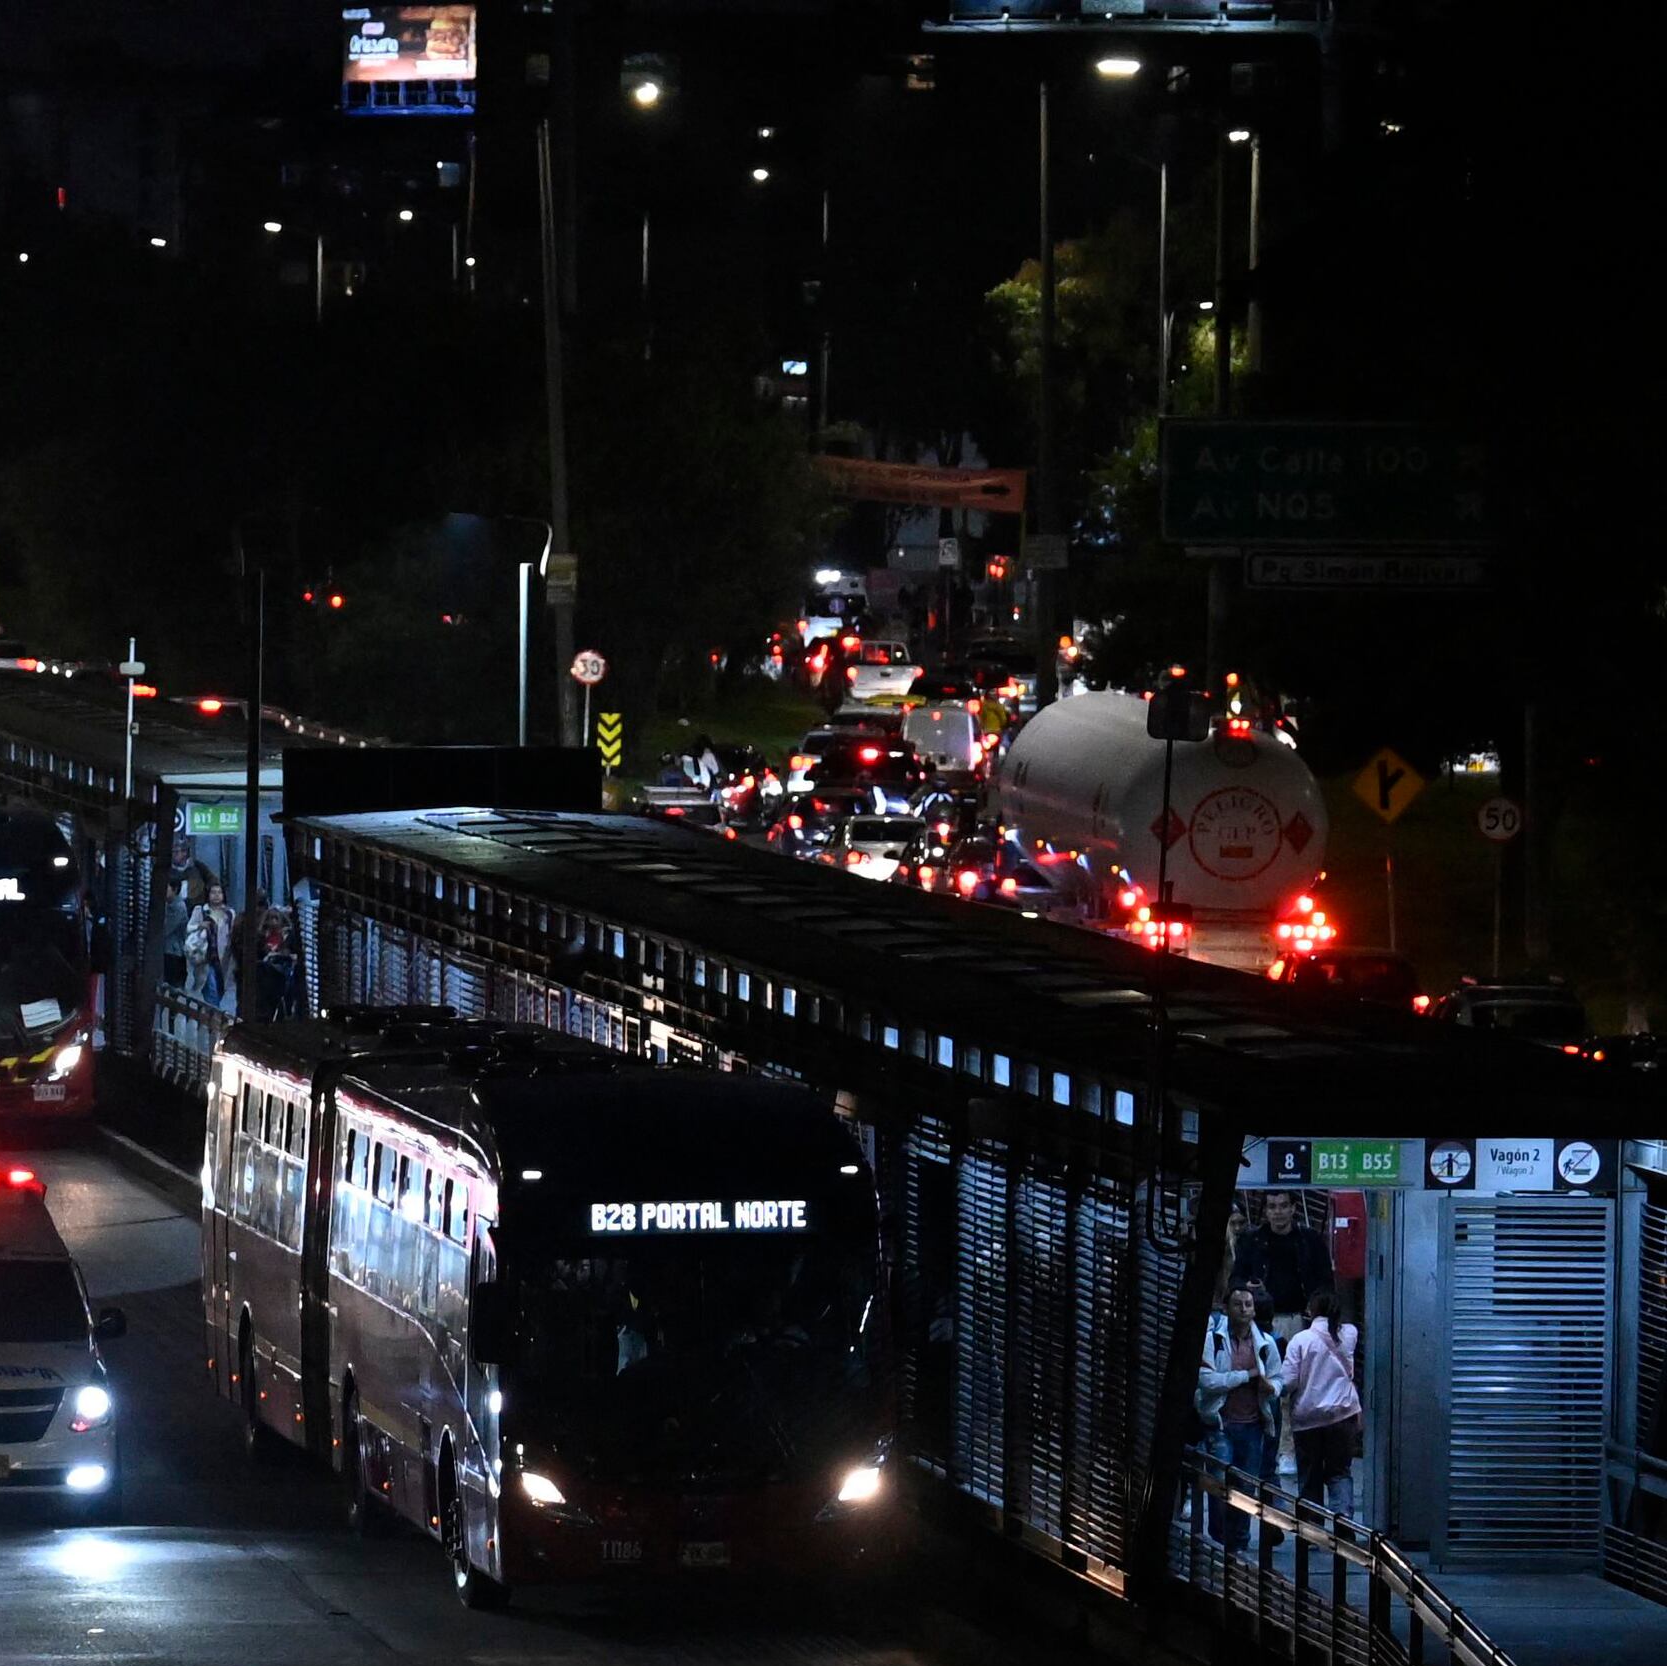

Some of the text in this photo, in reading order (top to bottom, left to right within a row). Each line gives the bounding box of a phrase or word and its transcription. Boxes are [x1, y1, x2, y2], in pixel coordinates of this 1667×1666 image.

[1485, 807, 1516, 831] 50
[1284, 1153, 1392, 1170] 8 B13 B55
[1490, 1147, 1540, 1165] Vagón 2
[591, 1200, 807, 1231] B28 PORTAL NORTE
